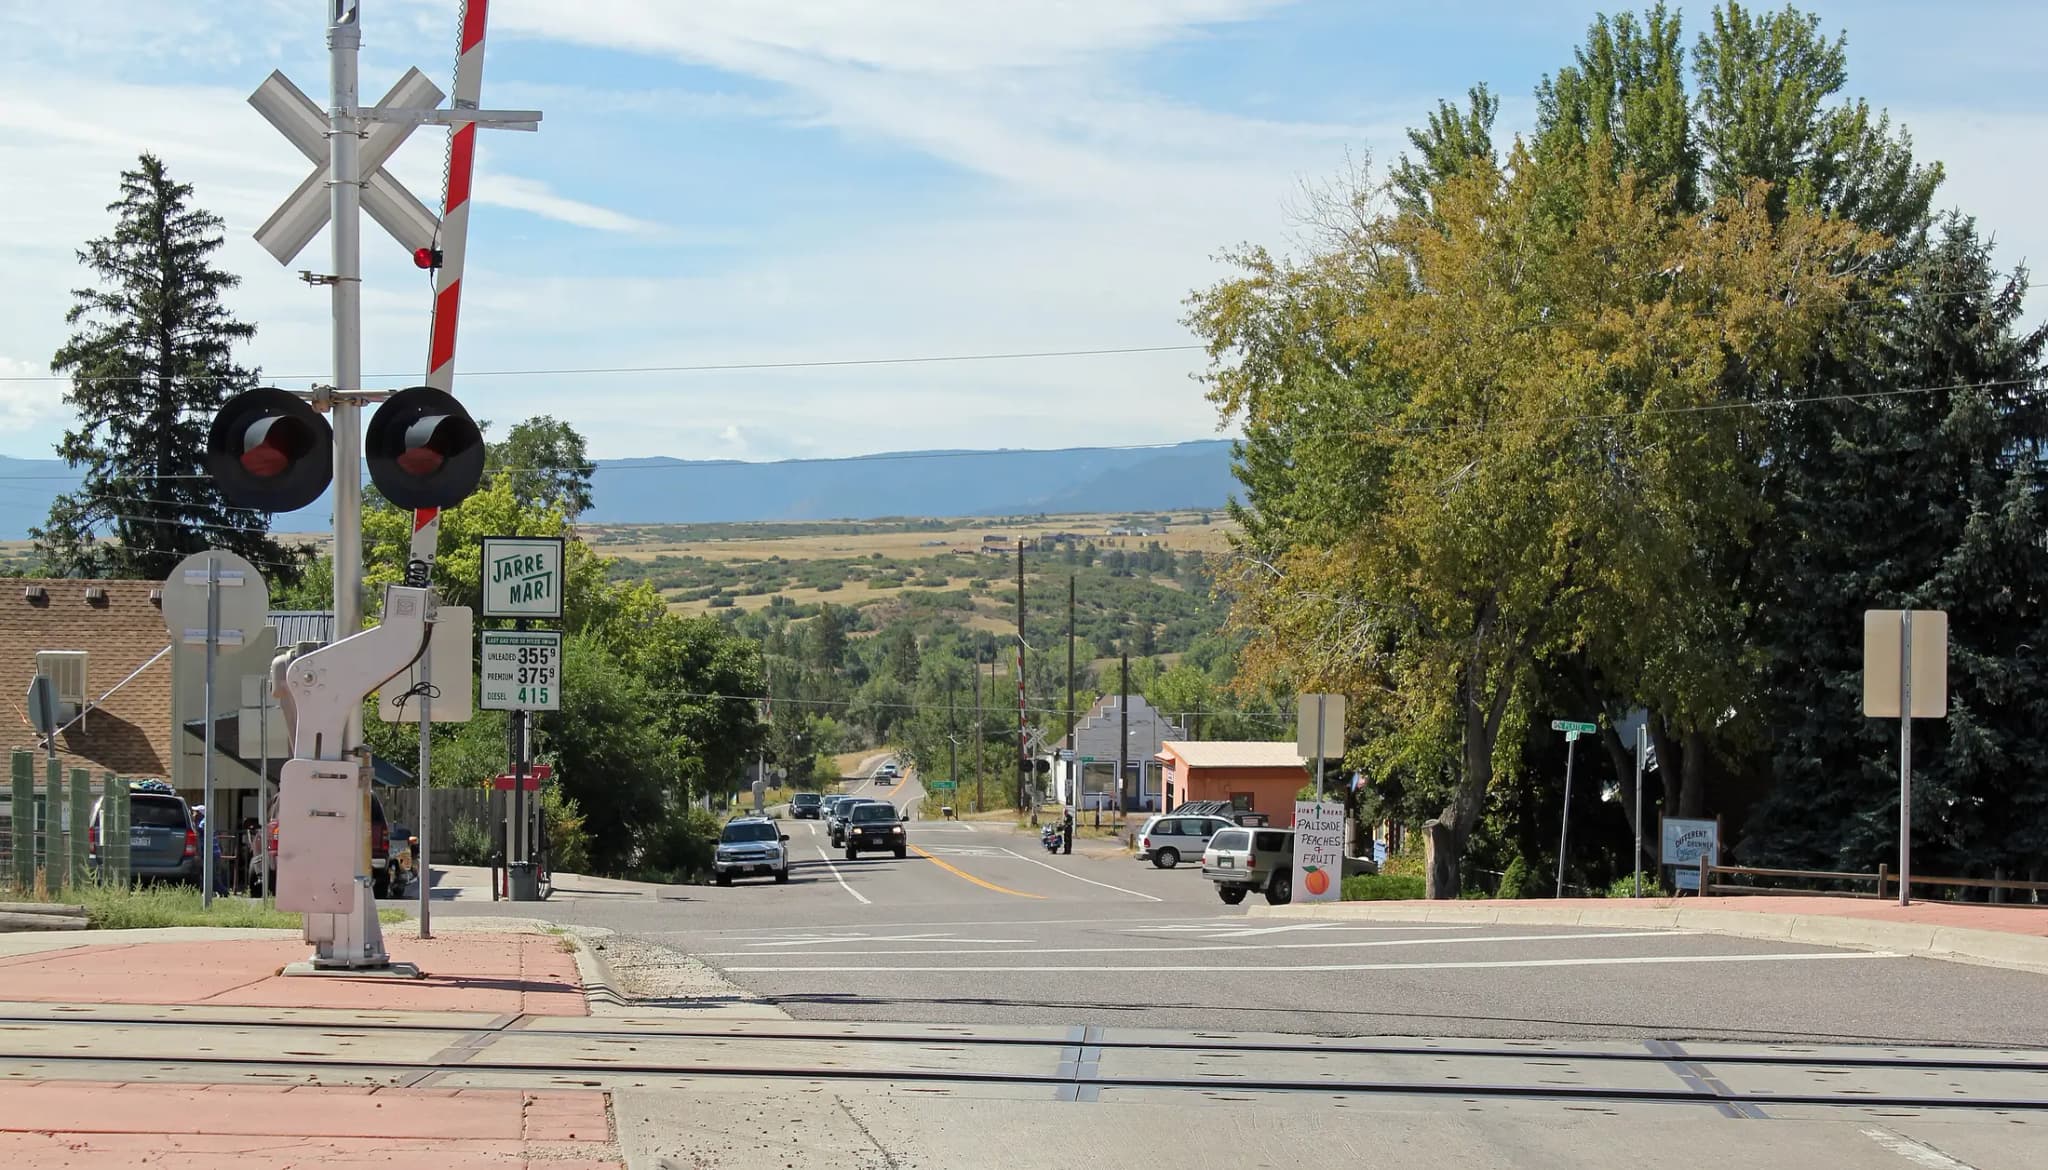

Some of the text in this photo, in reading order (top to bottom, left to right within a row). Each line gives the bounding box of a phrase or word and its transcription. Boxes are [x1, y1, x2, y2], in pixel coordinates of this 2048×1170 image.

[493, 553, 544, 583] JARRE
[510, 571, 553, 604] MART
[488, 653, 517, 661] UNLEADED
[487, 673, 514, 681] PREMIUM
[487, 687, 549, 704] DIESEL 415
[1297, 818, 1341, 832] PALISADE
[1301, 834, 1341, 847] PEACHES
[1675, 830, 1707, 848] DIFFERENT
[1302, 854, 1336, 865] FRUIT
